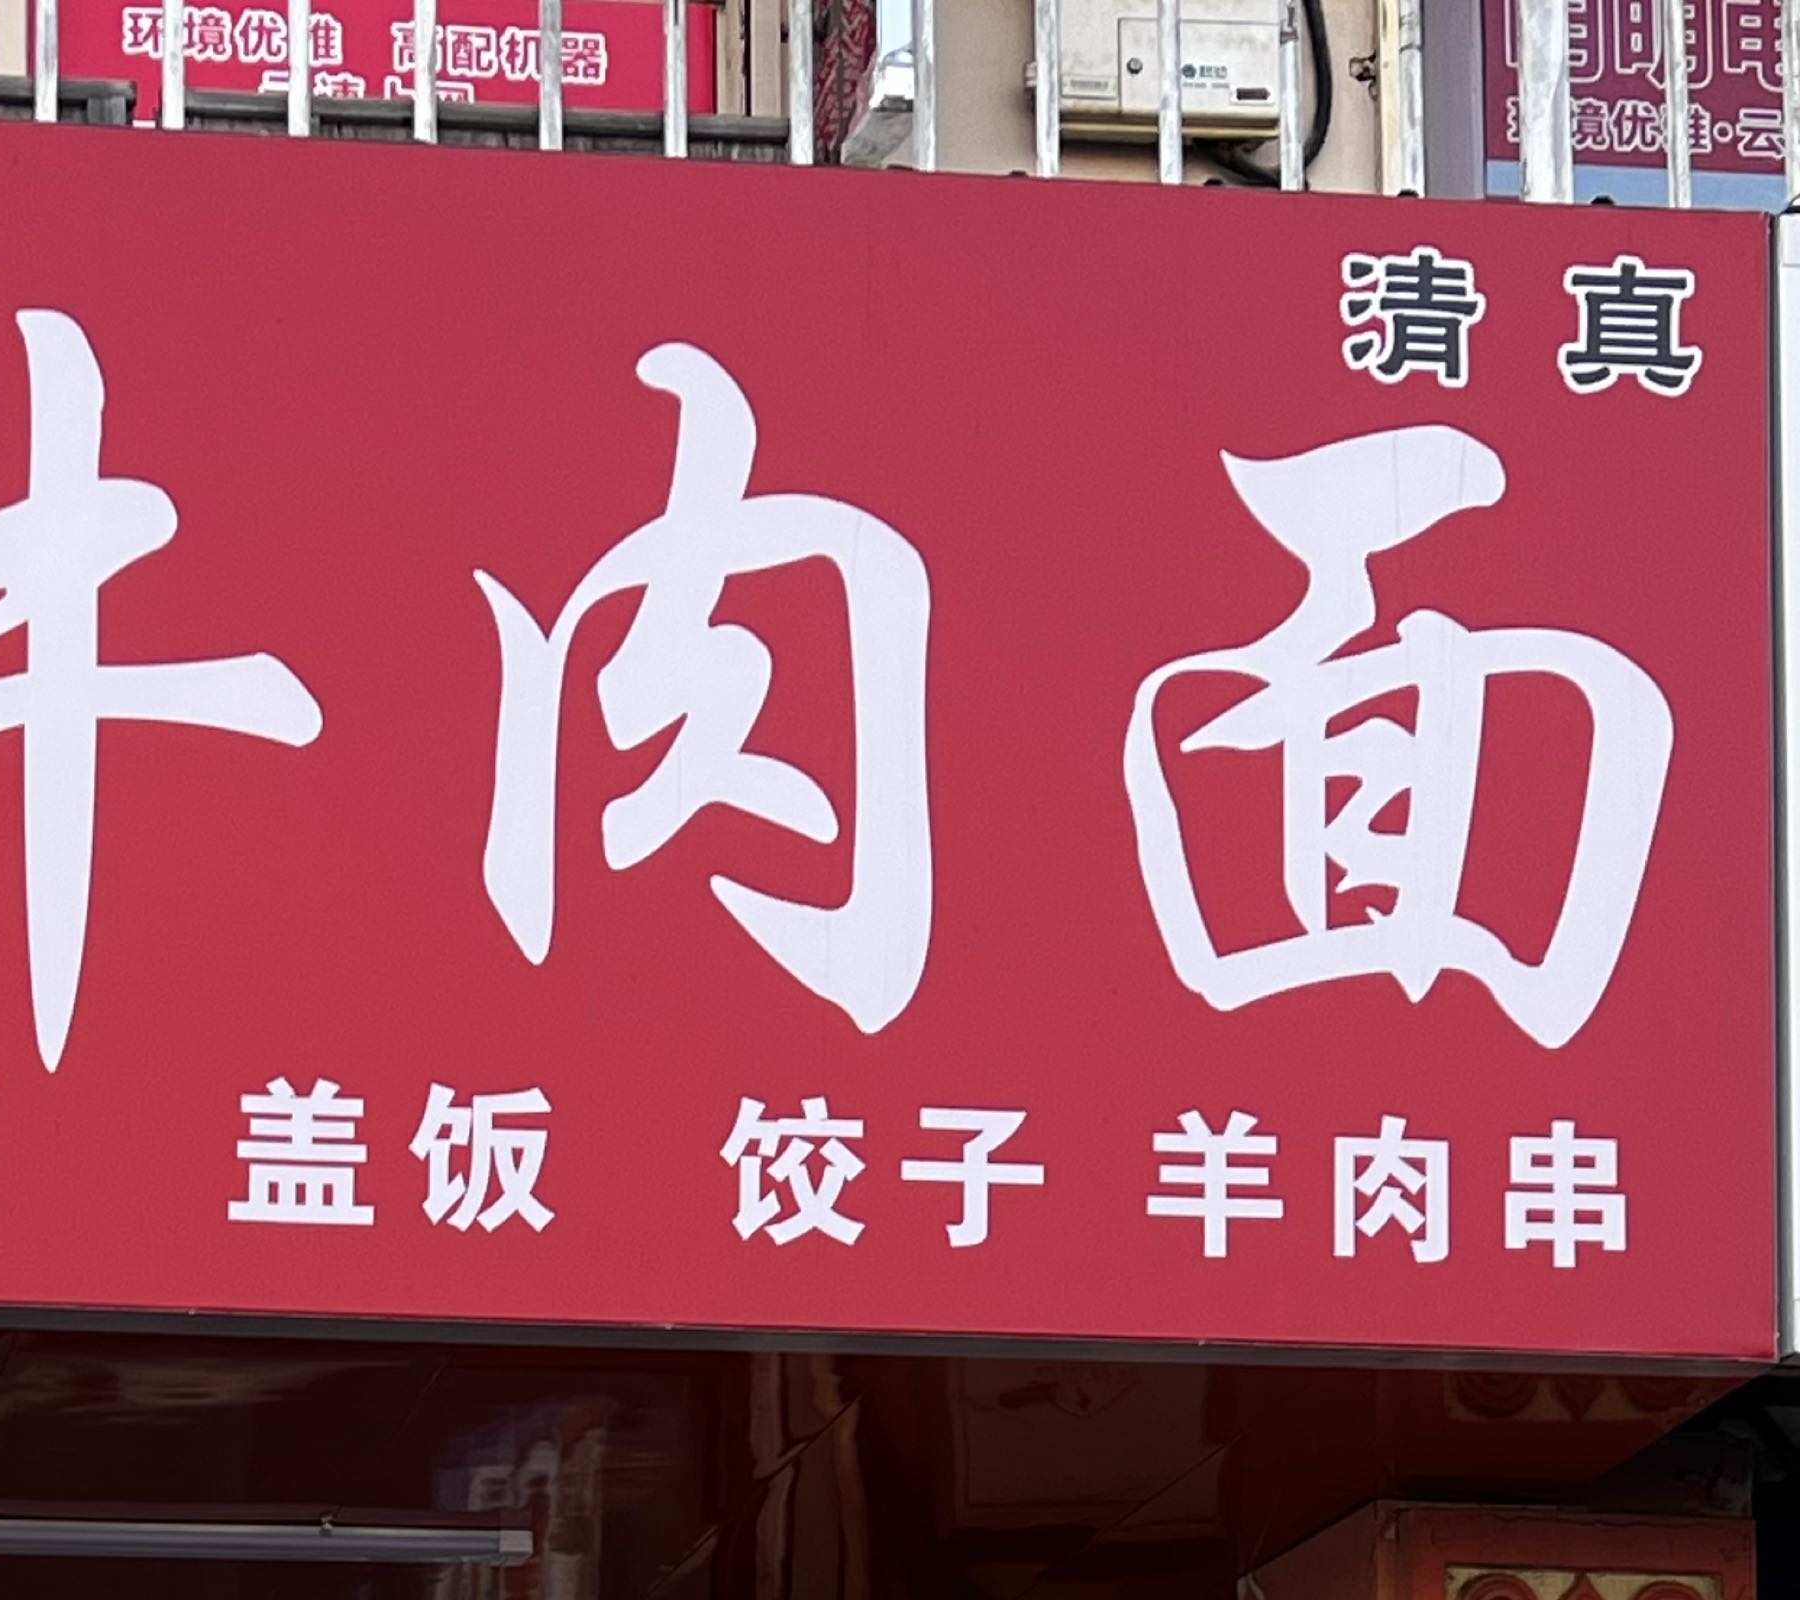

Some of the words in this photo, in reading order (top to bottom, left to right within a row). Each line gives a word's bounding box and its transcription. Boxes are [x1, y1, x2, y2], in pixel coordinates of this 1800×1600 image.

[1342, 247, 1701, 396] 清真
[228, 1077, 556, 1232] 盖饭
[721, 1097, 1045, 1248] 饺子
[1146, 1110, 1628, 1268] 羊肉串
